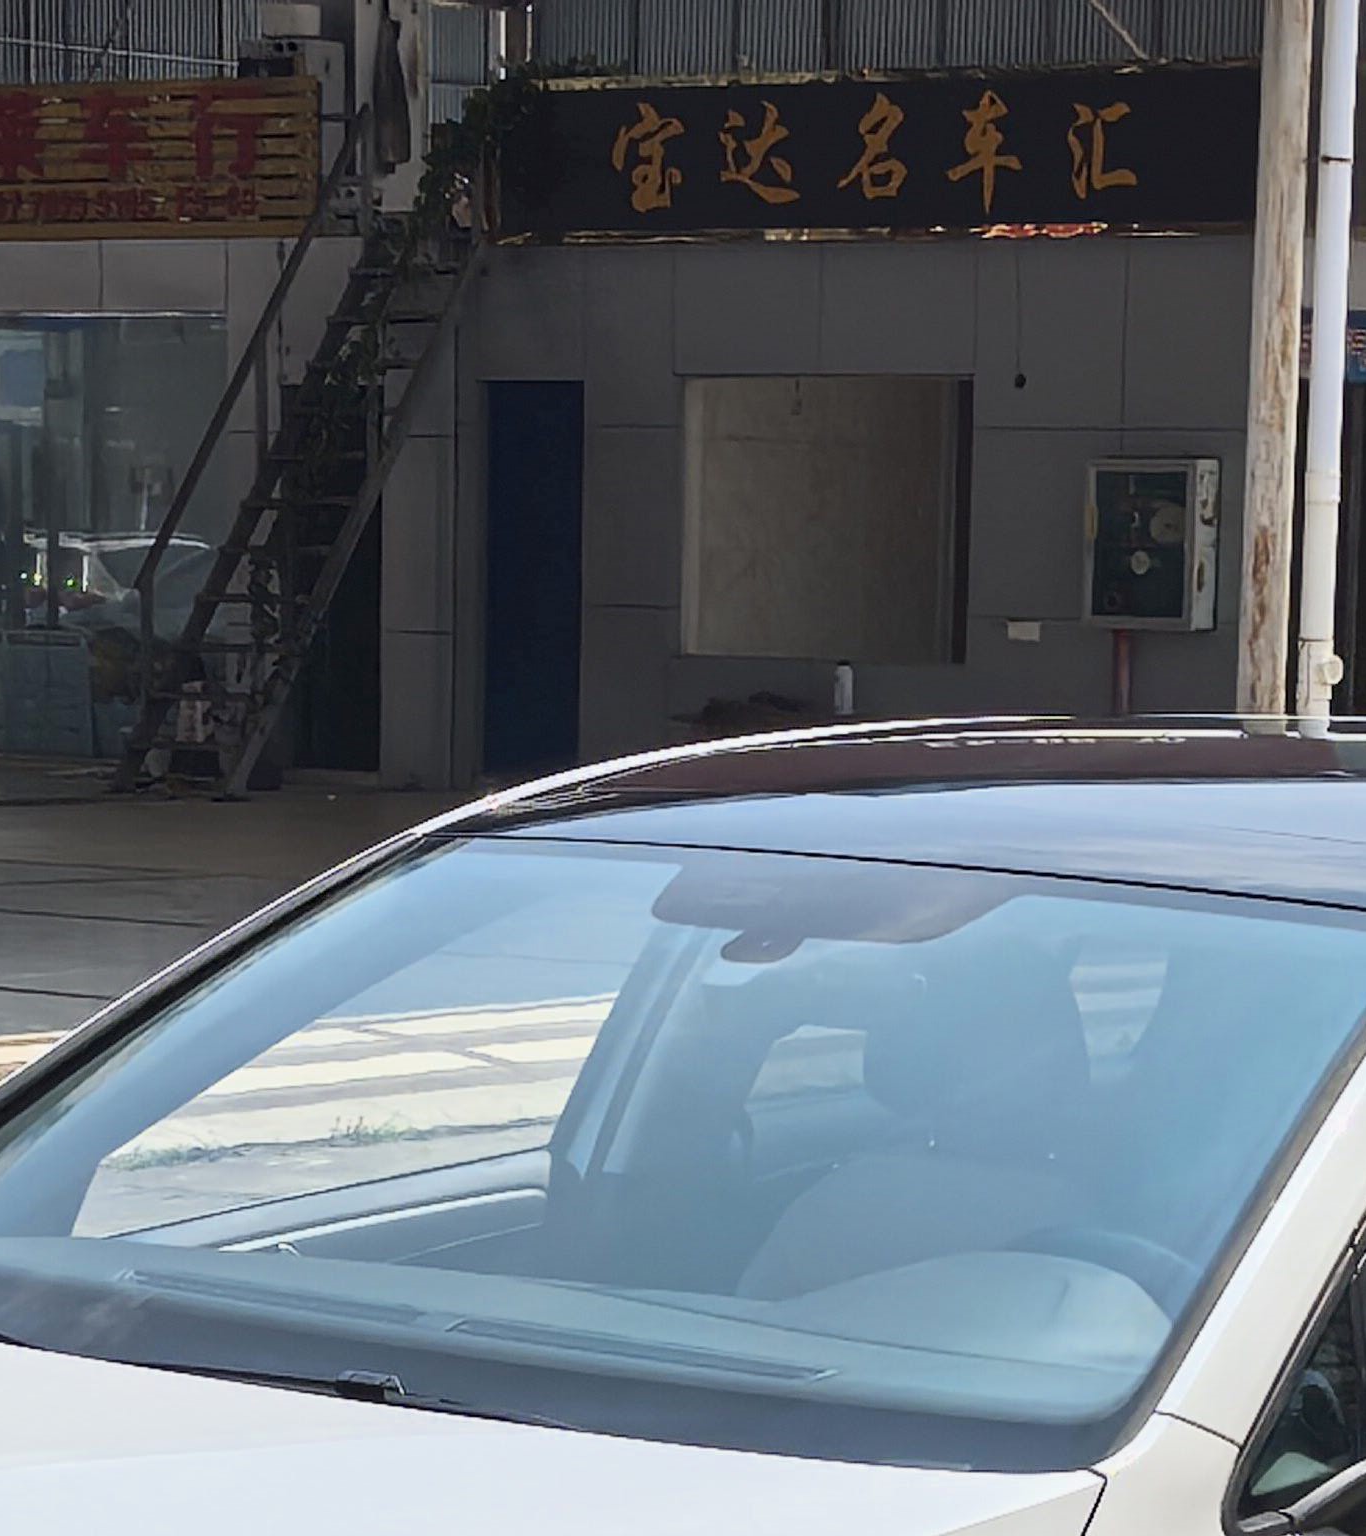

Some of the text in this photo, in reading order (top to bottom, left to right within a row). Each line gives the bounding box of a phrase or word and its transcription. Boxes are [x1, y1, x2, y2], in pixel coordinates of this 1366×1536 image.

[611, 90, 1137, 214] 宝达名车汇
